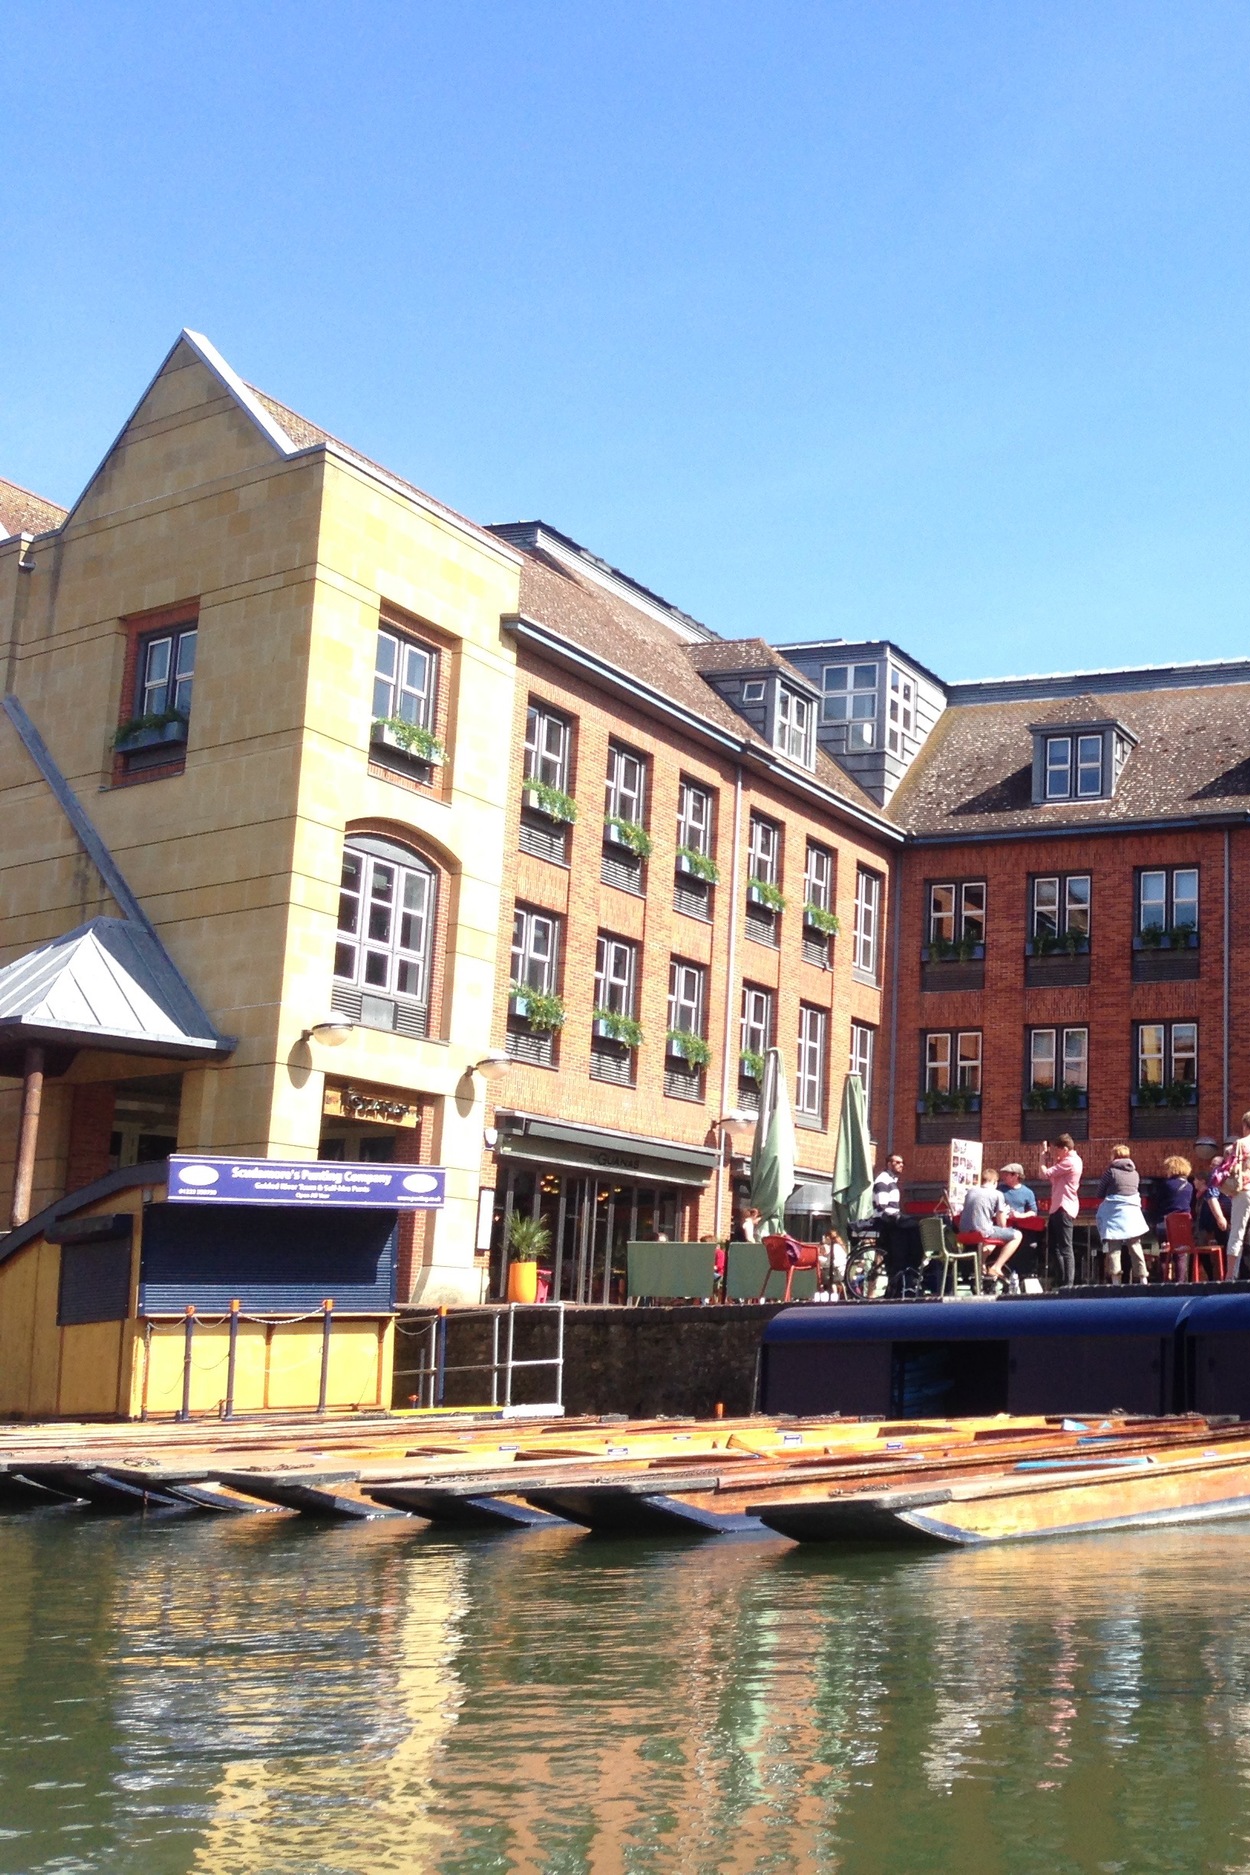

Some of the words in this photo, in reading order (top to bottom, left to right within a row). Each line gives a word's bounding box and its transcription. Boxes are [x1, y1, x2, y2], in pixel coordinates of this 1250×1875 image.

[231, 1166, 300, 1181] Scudamore's
[301, 1169, 343, 1184] Punting
[344, 1171, 392, 1186] Company
